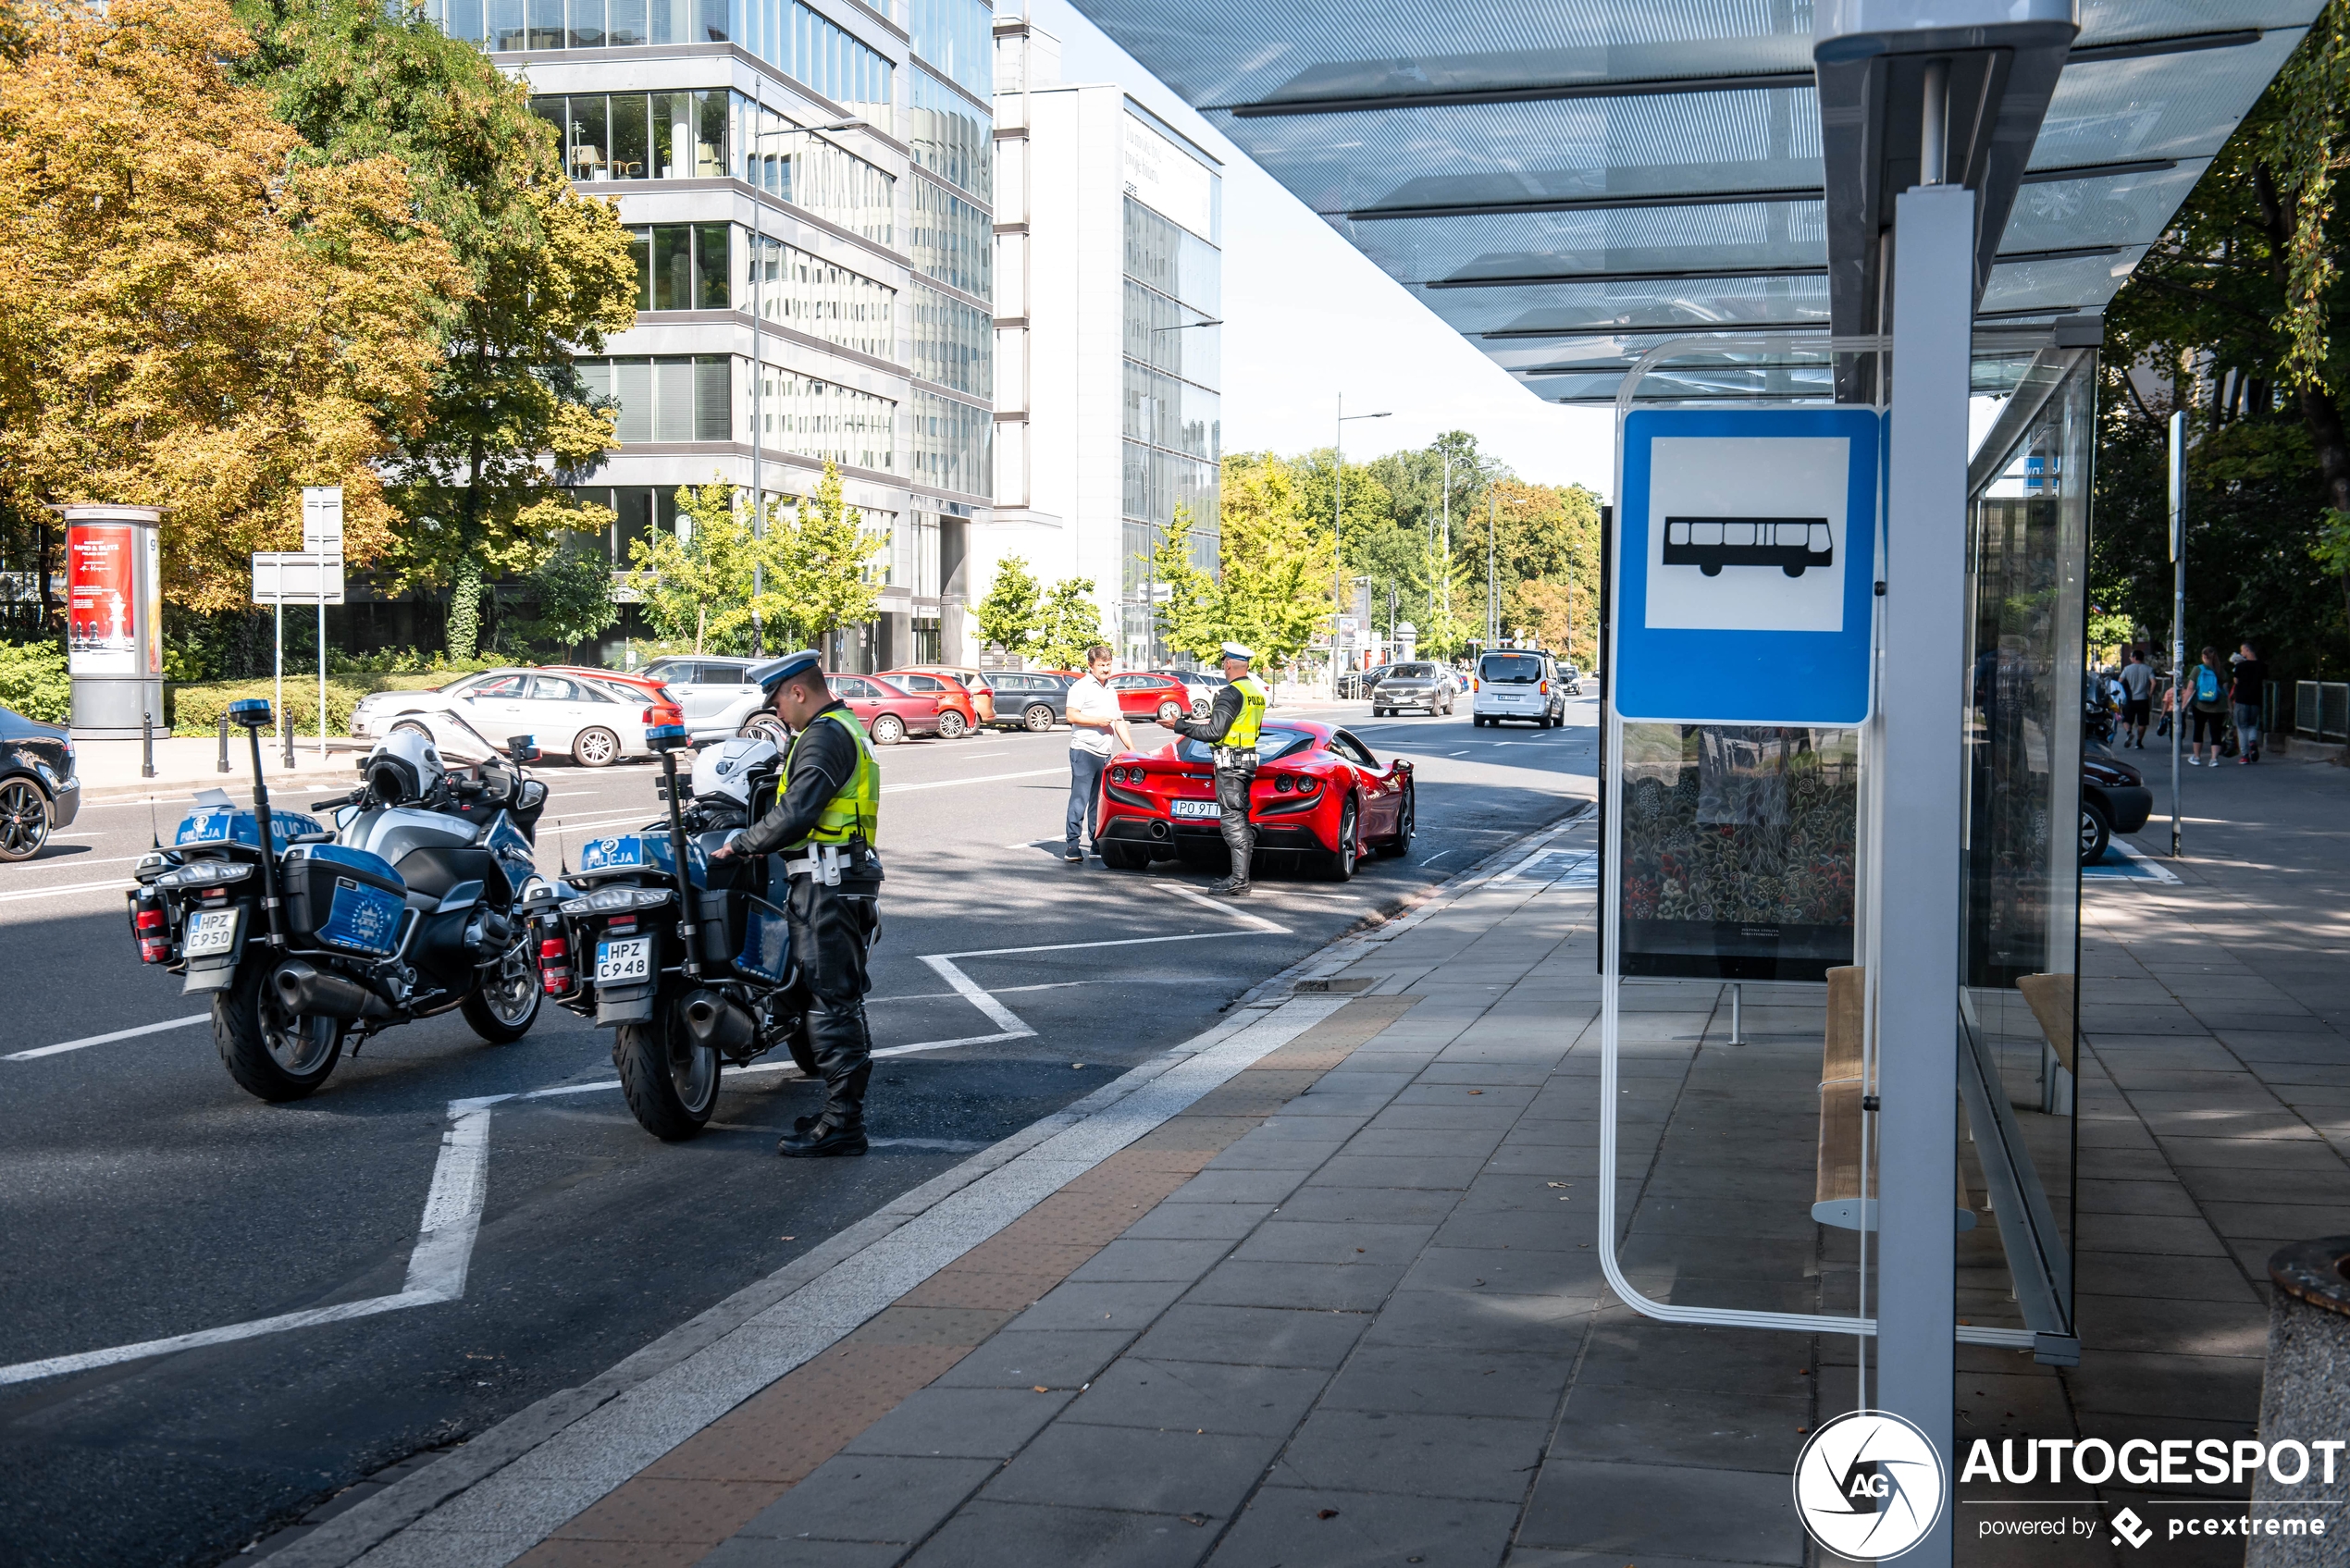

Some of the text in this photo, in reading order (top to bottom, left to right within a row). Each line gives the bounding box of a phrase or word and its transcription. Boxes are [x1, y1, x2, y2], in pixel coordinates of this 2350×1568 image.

[1199, 803, 1220, 816] 9TT
[180, 827, 221, 843] POLICJA
[271, 820, 316, 838] OLICJA
[588, 851, 634, 868] POLICJA
[201, 914, 229, 930] HPZ
[191, 931, 229, 947] C950
[611, 943, 640, 959] HPZ
[600, 959, 645, 978] C948
